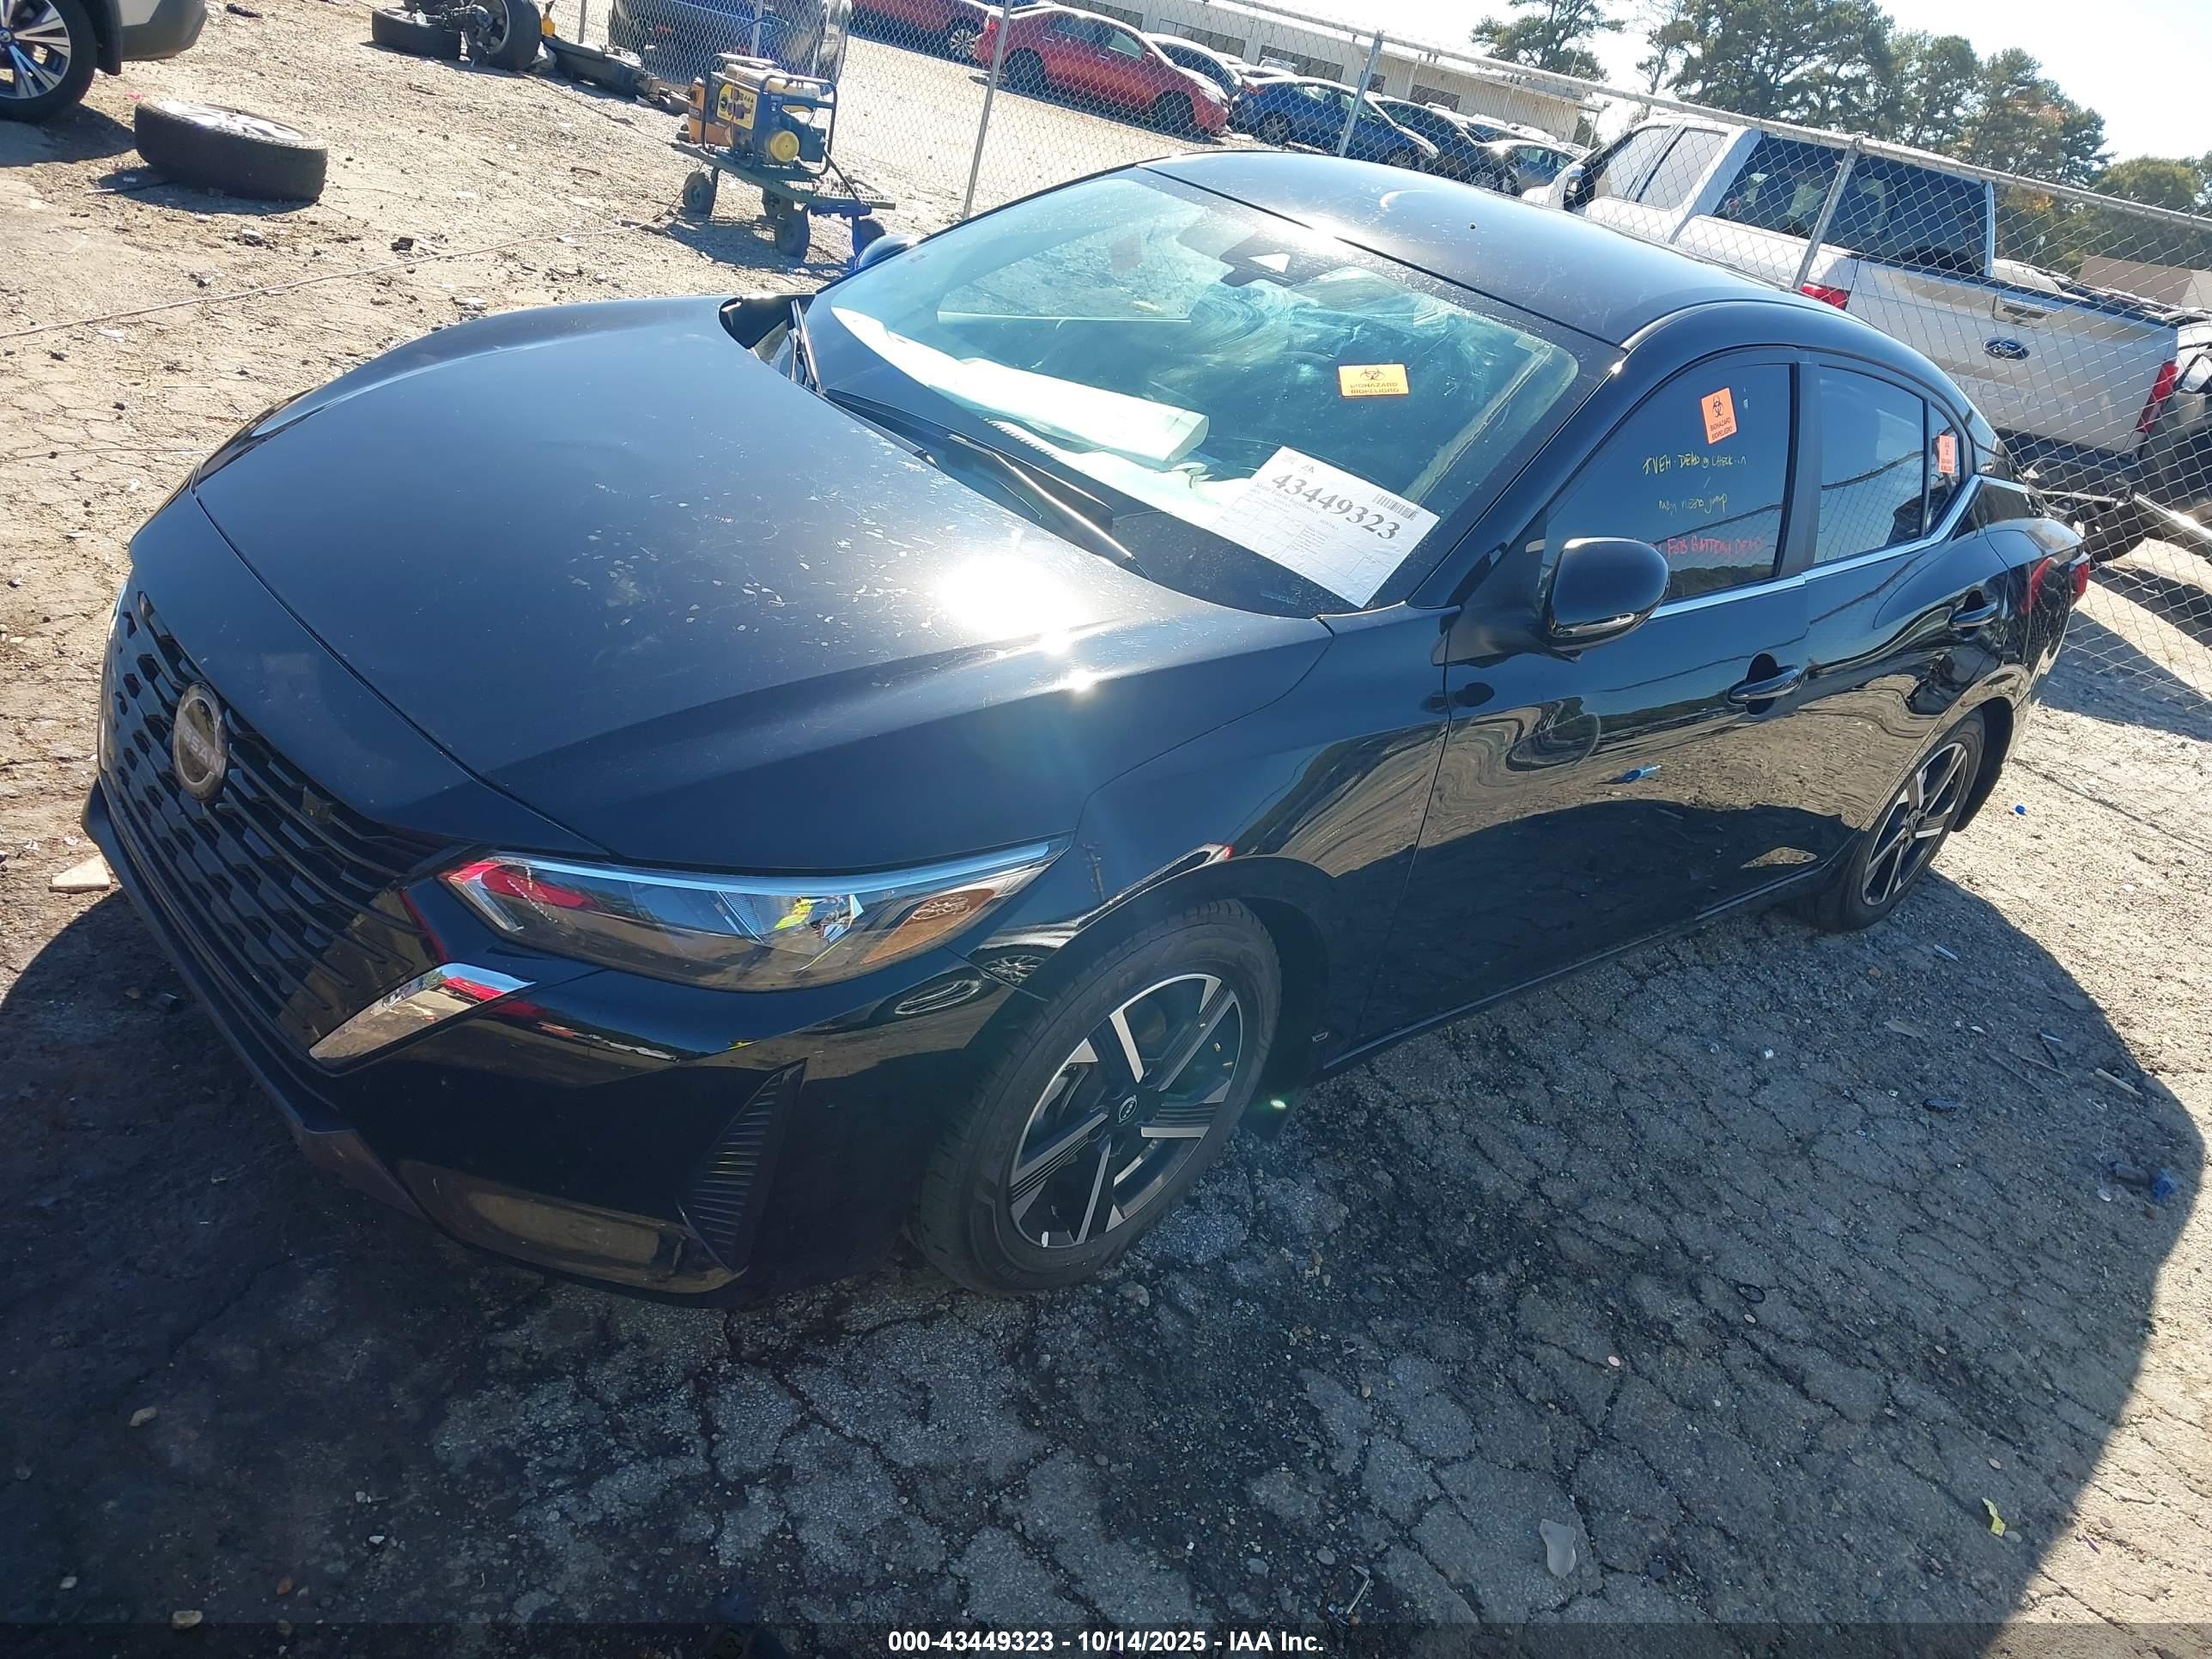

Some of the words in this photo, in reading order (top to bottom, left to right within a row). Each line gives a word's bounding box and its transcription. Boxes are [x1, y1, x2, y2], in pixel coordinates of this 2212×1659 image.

[1711, 416, 1732, 431] BIOHAZARD
[1272, 474, 1401, 539] 43449323
[182, 725, 222, 772] SSAN
